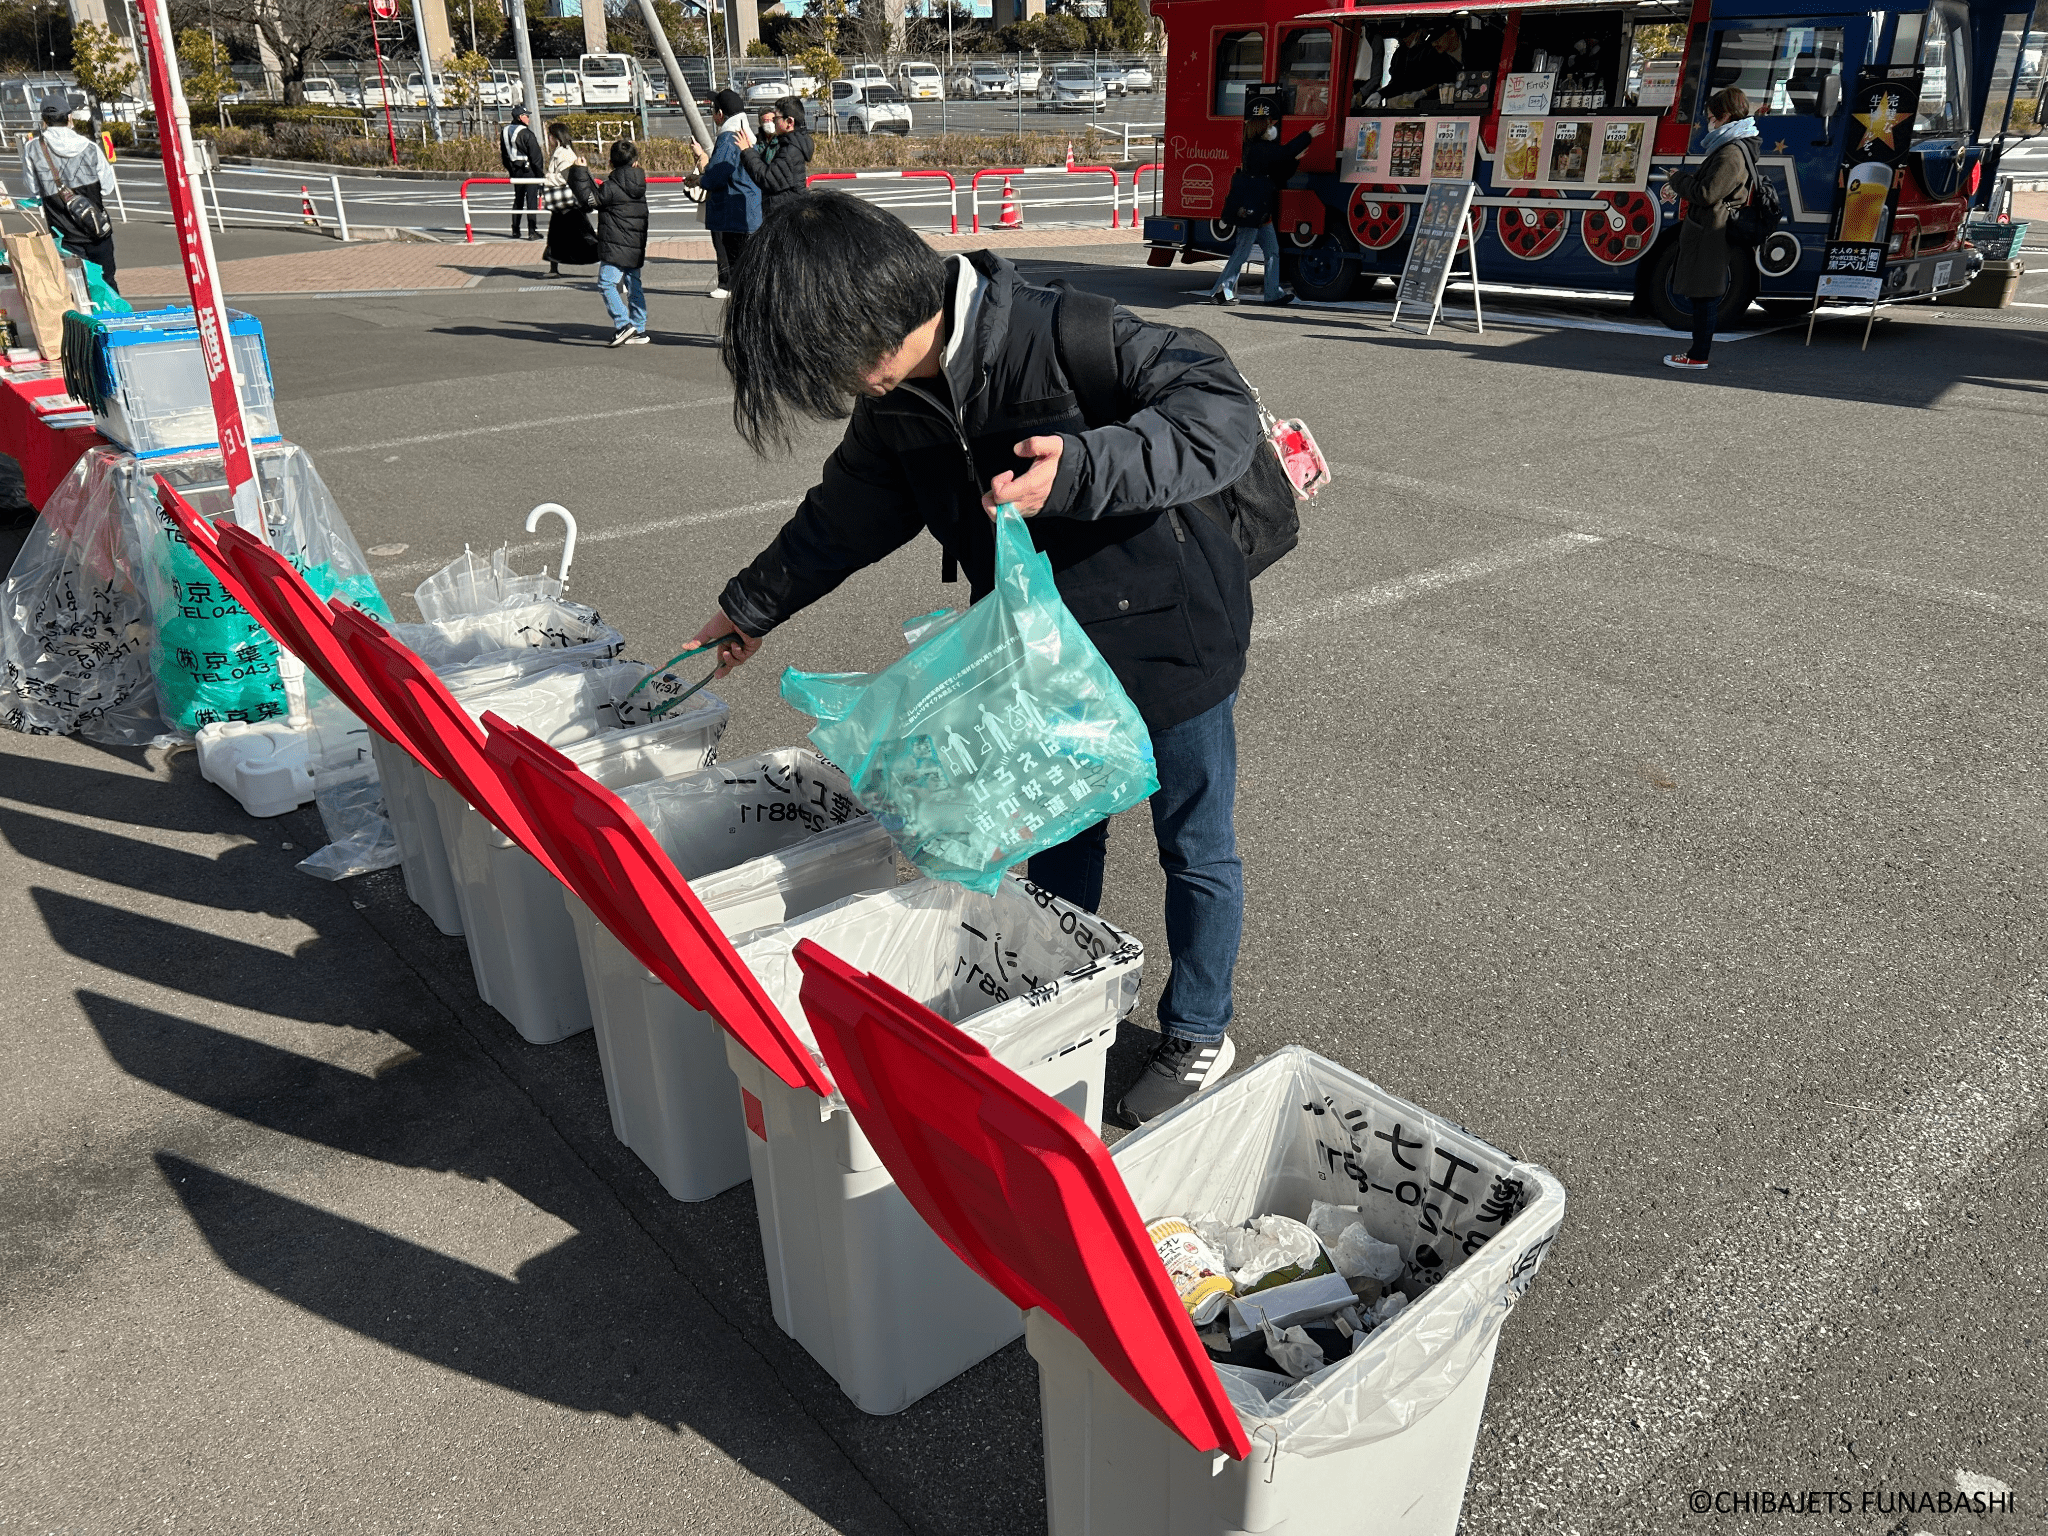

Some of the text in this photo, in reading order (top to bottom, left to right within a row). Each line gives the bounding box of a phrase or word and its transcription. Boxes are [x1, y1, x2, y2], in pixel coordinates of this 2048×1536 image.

[1830, 247, 1853, 255] 大人の
[1826, 260, 1866, 271] 黒ラベル
[190, 671, 230, 684] TEL
[971, 750, 1091, 835] 街が好きに
[1000, 777, 1093, 846] なる運動
